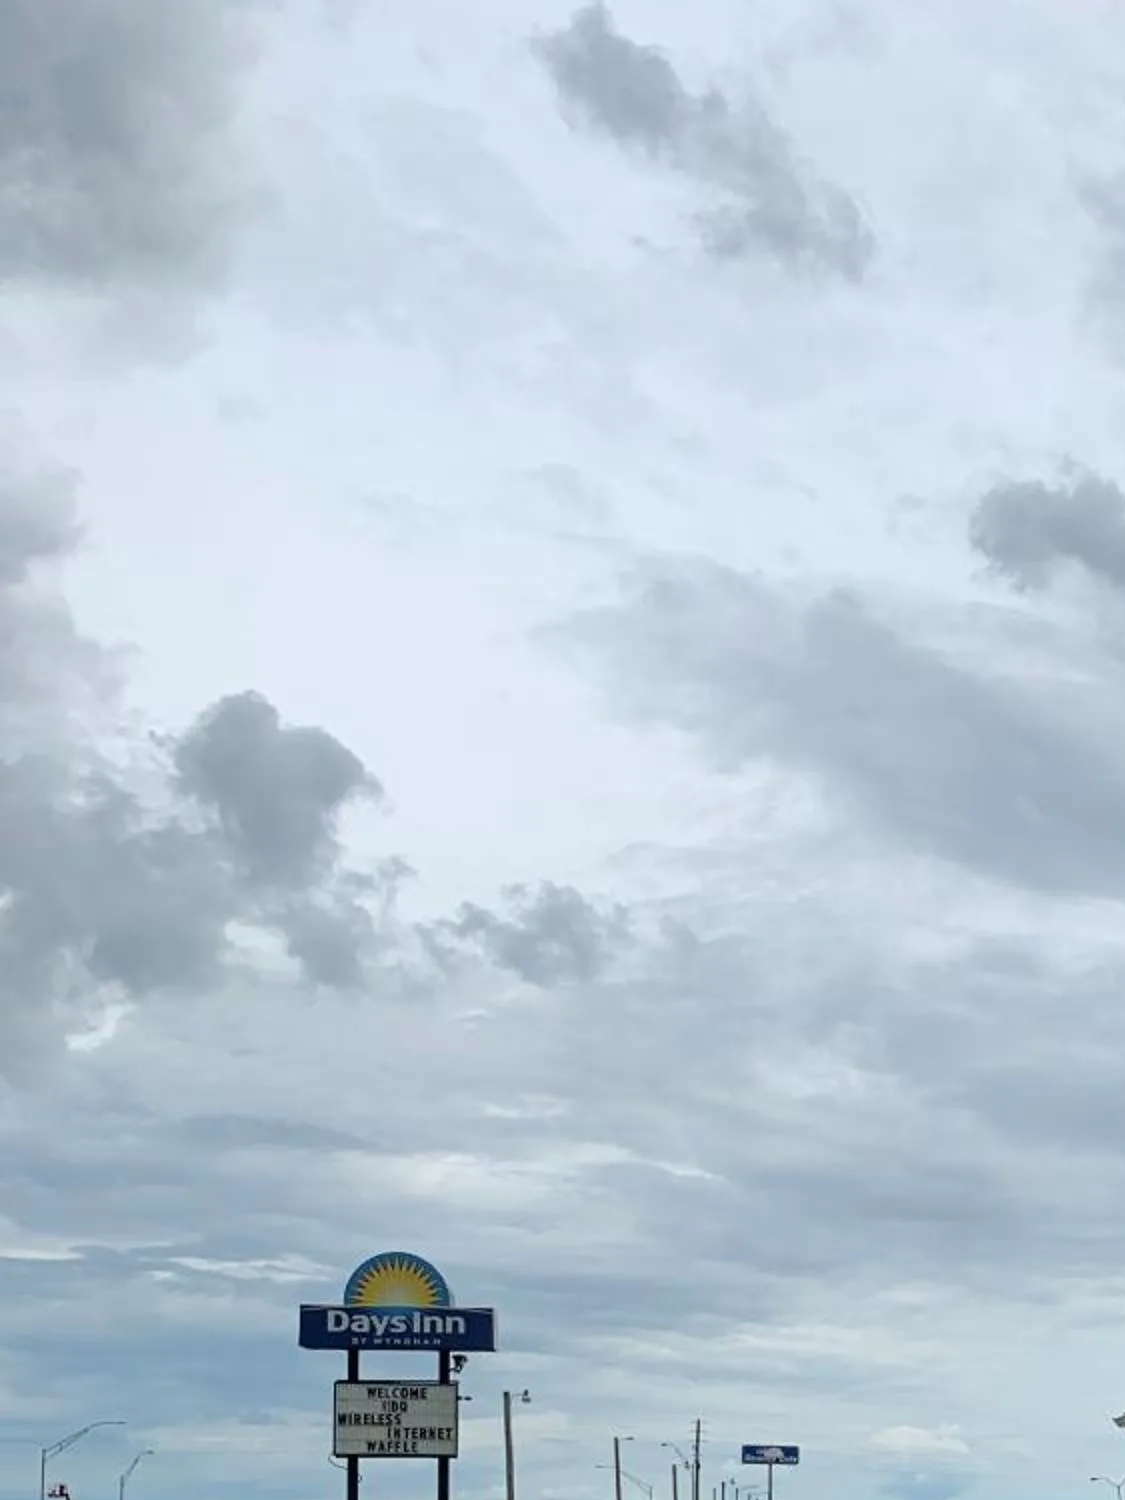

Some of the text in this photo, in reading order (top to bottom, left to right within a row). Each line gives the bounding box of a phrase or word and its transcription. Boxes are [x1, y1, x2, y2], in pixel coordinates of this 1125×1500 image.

[327, 1309, 466, 1336] Days Inn
[366, 1387, 428, 1400] WELCOME
[337, 1412, 401, 1426] WIRELESS
[387, 1427, 453, 1440] INTERNET
[366, 1441, 418, 1453] WAFFLE
